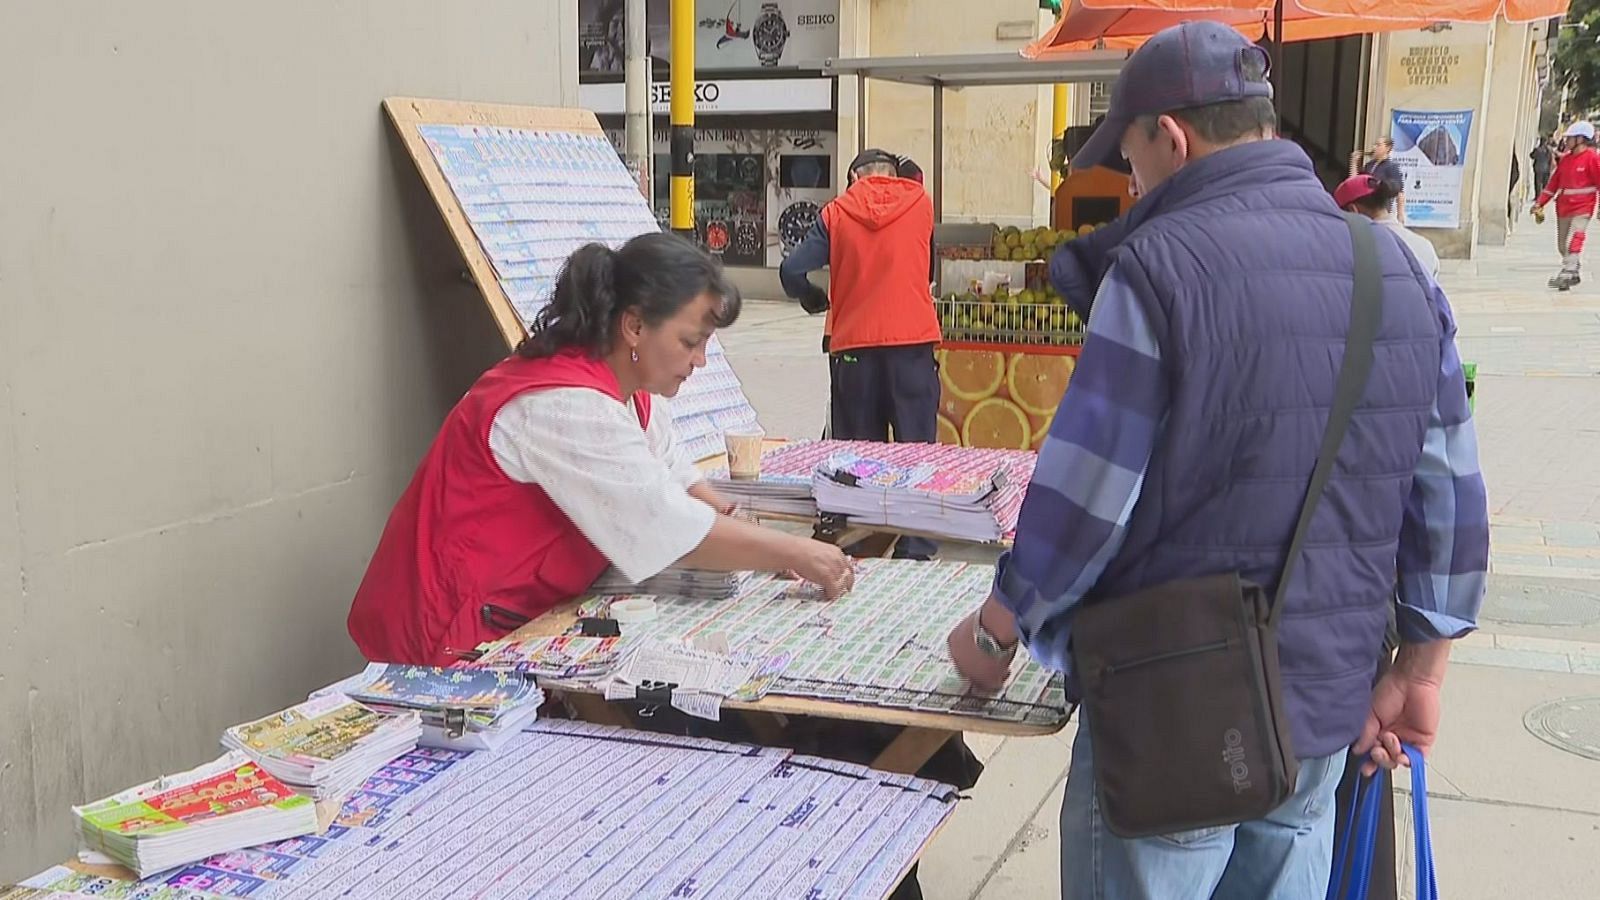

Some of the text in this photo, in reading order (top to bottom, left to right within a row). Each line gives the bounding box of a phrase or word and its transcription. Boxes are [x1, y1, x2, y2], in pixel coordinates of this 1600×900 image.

[797, 14, 835, 26] SEIKO
[652, 83, 719, 104] SEKO
[693, 129, 746, 142] GINEBRA
